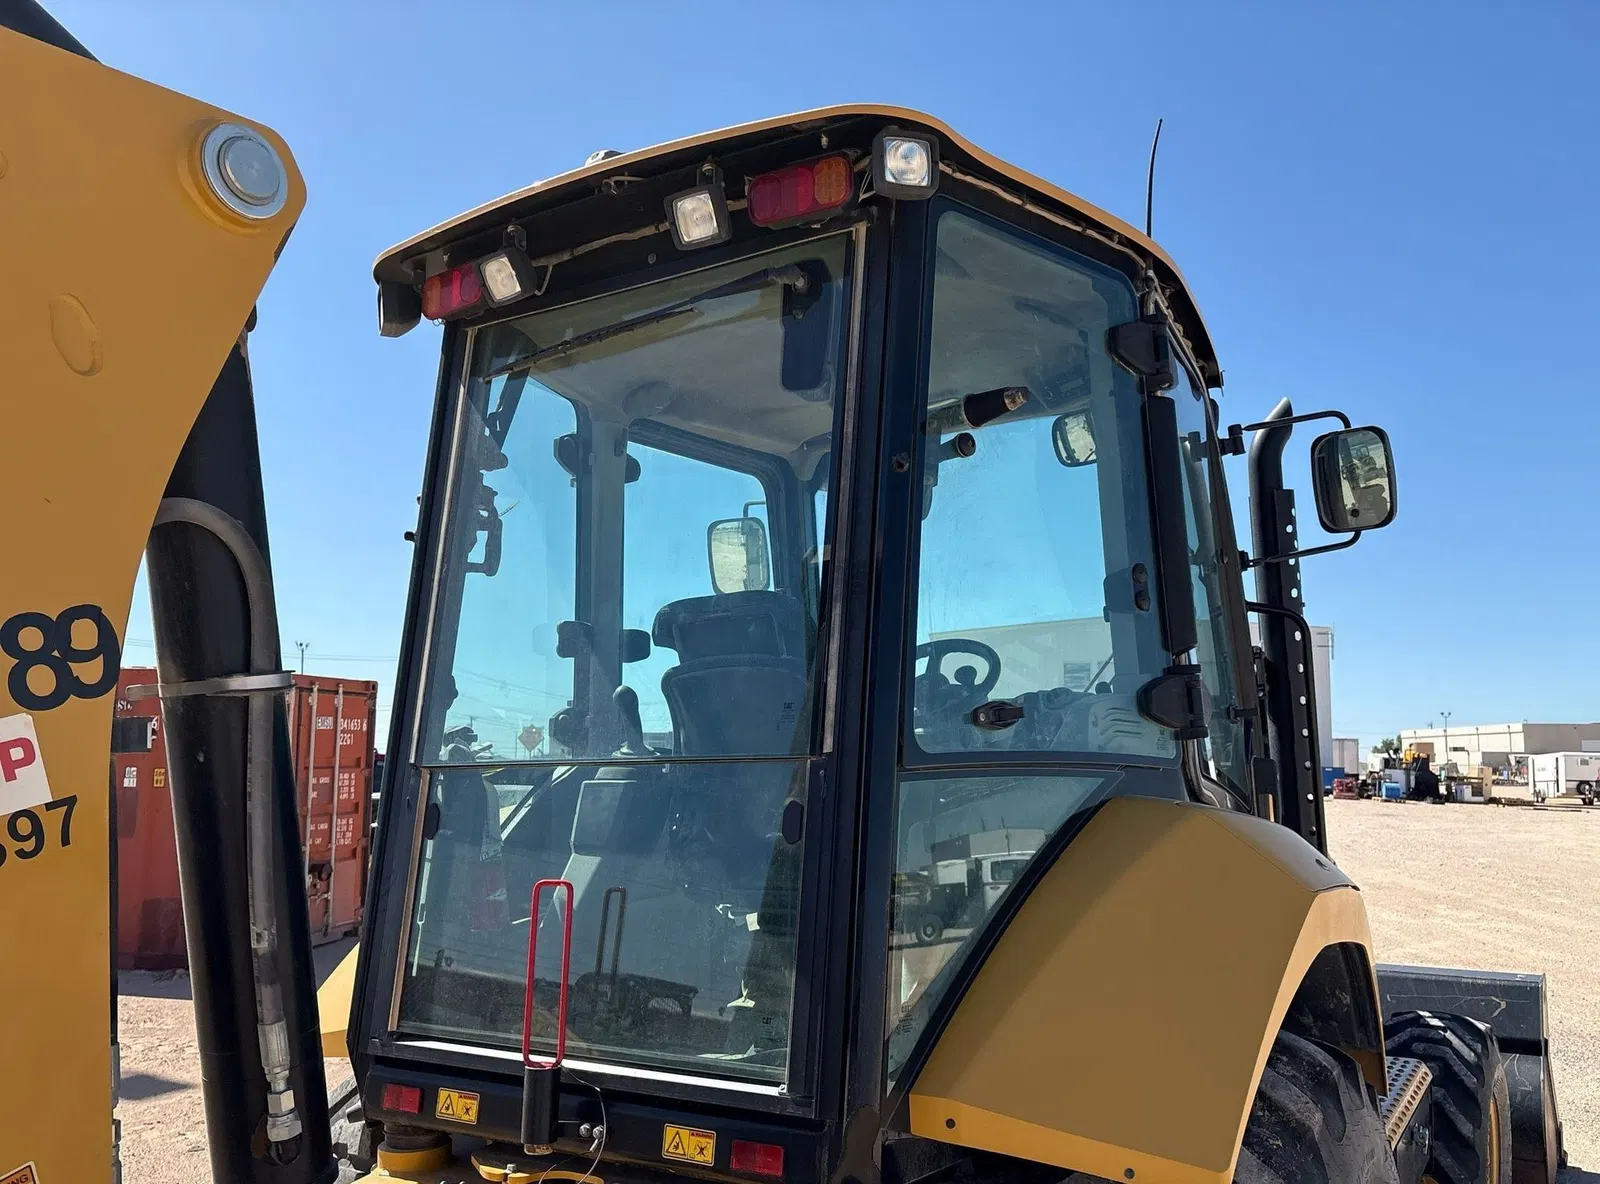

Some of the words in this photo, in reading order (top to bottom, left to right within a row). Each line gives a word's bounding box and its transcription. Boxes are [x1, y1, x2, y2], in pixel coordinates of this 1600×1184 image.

[0, 604, 120, 711] 89
[340, 718, 361, 731] 341653
[0, 795, 78, 867] 97
